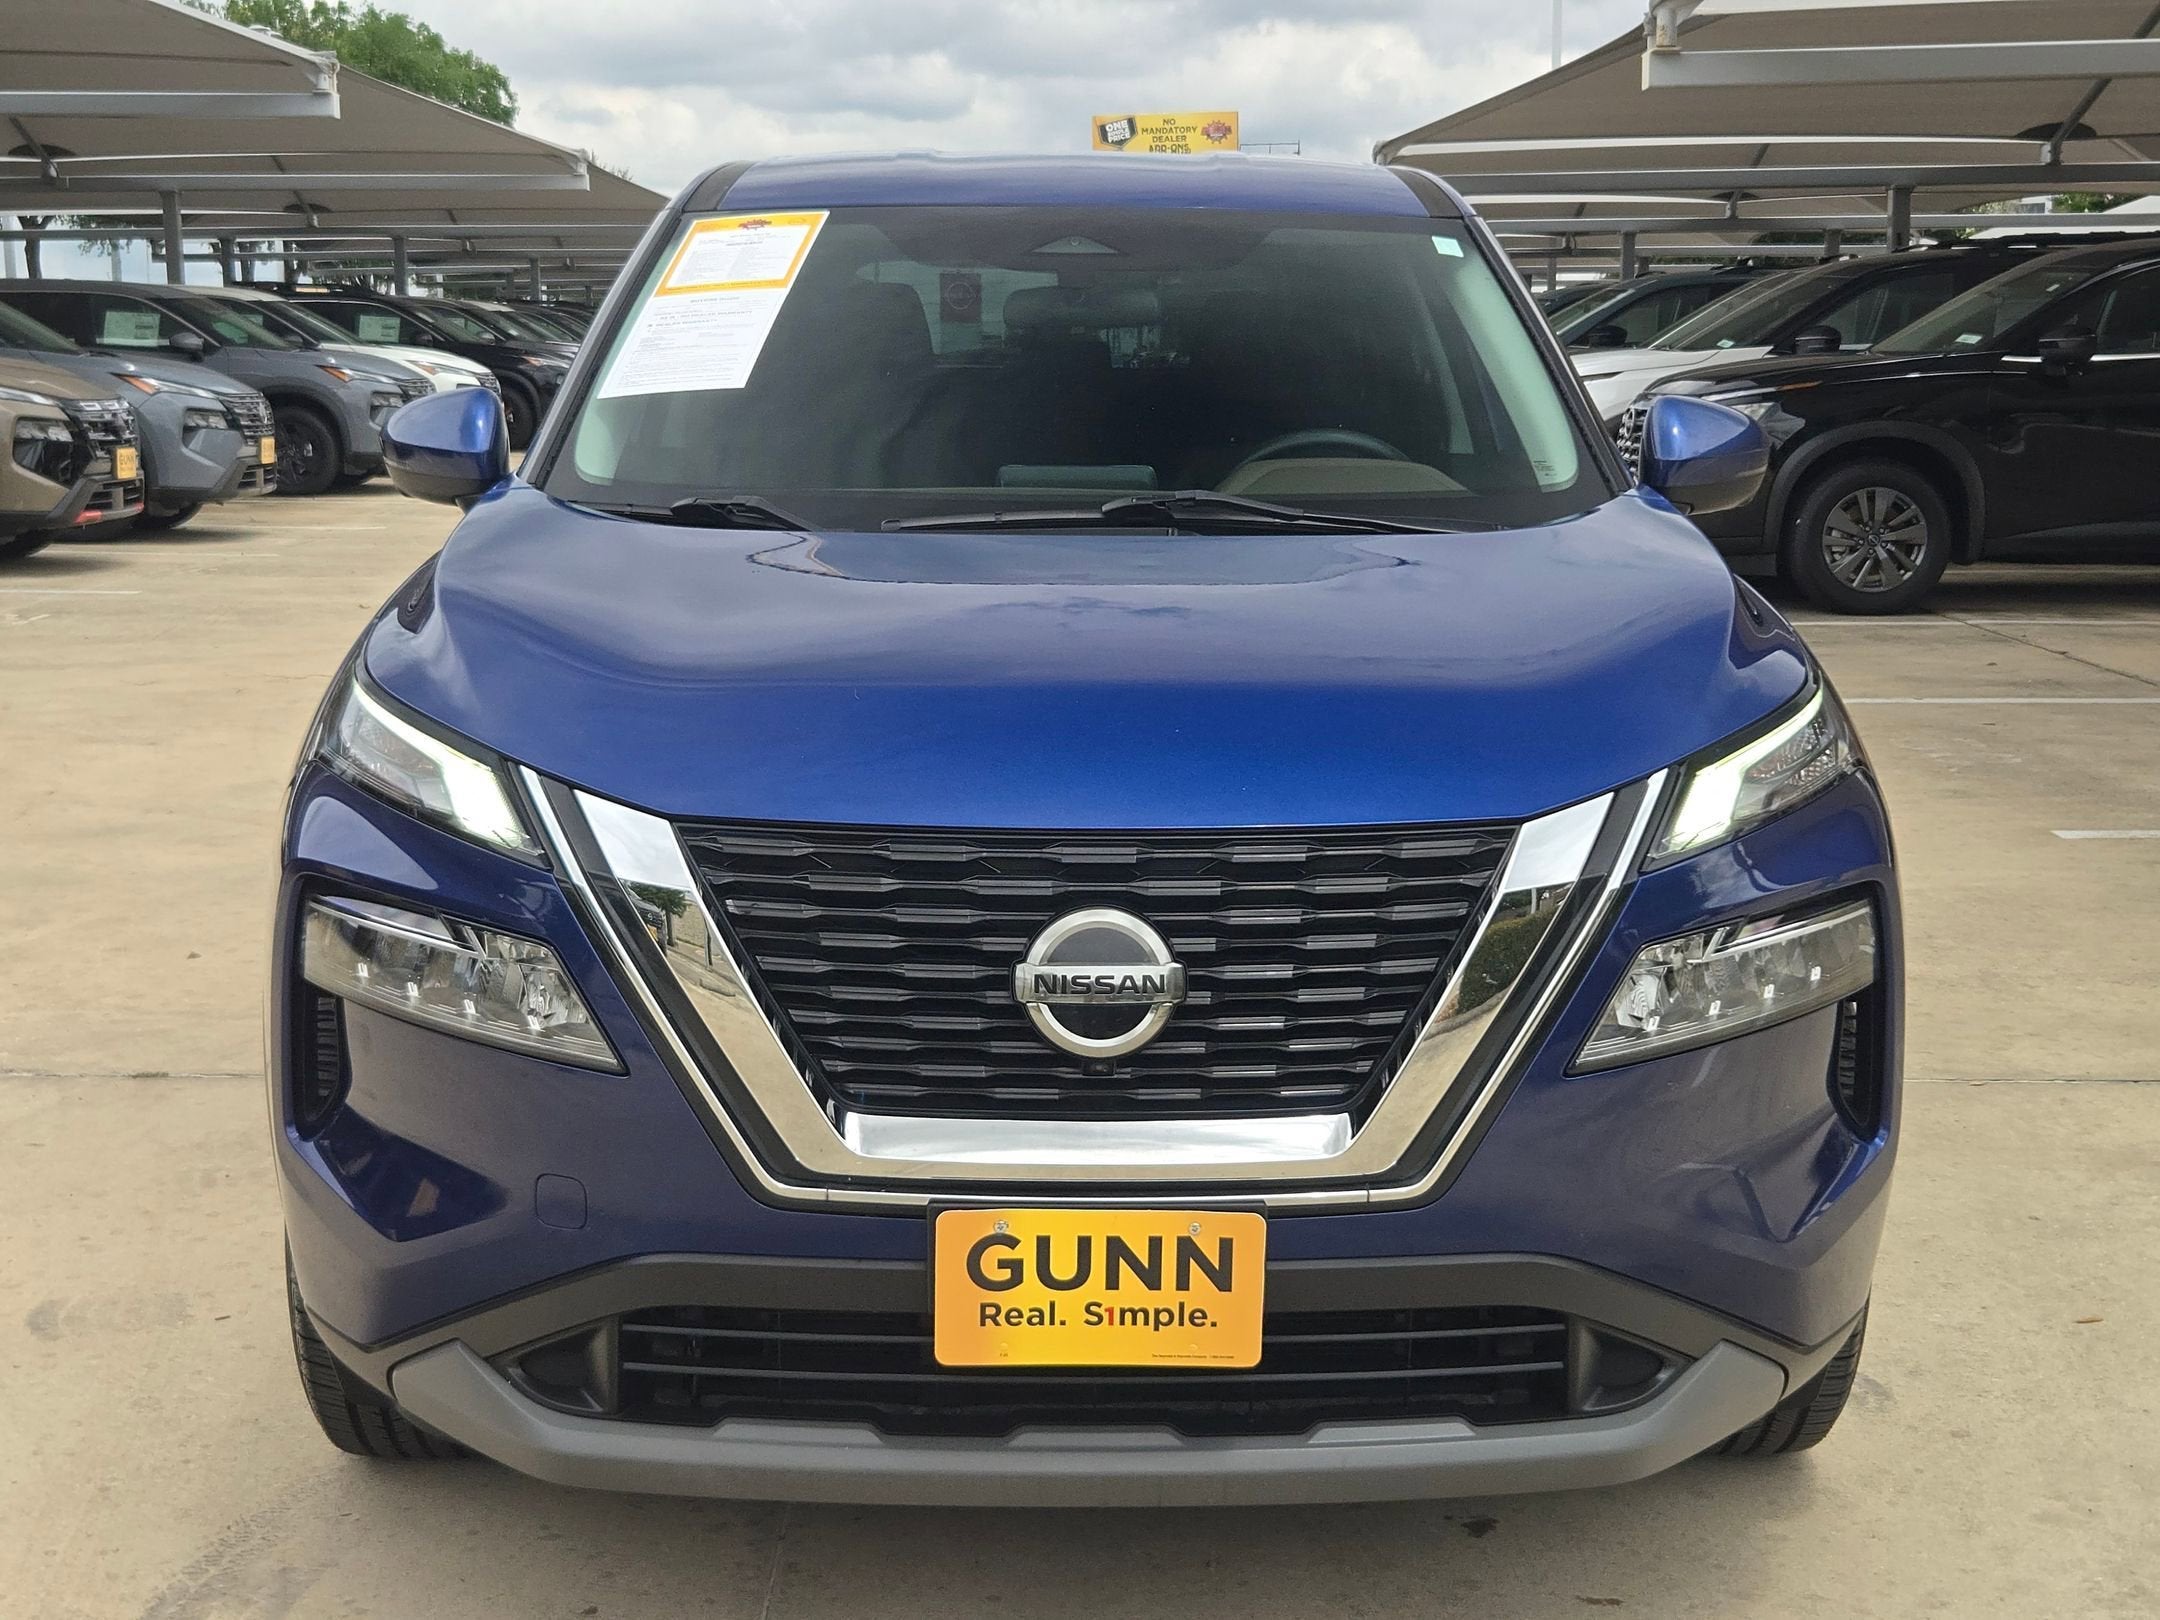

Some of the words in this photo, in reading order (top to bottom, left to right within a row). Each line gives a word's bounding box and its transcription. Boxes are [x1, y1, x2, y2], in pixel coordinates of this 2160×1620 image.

[1105, 119, 1129, 132] ONE
[1162, 118, 1176, 126] NO
[1141, 126, 1198, 135] MANDATORY
[1107, 132, 1131, 143] PRICE
[1152, 135, 1187, 143] DEALER
[1033, 974, 1165, 995] NISSAN
[966, 1232, 1234, 1293] GUNN
[979, 1300, 1067, 1327] Real.
[1083, 1300, 1218, 1332] S1mple.
